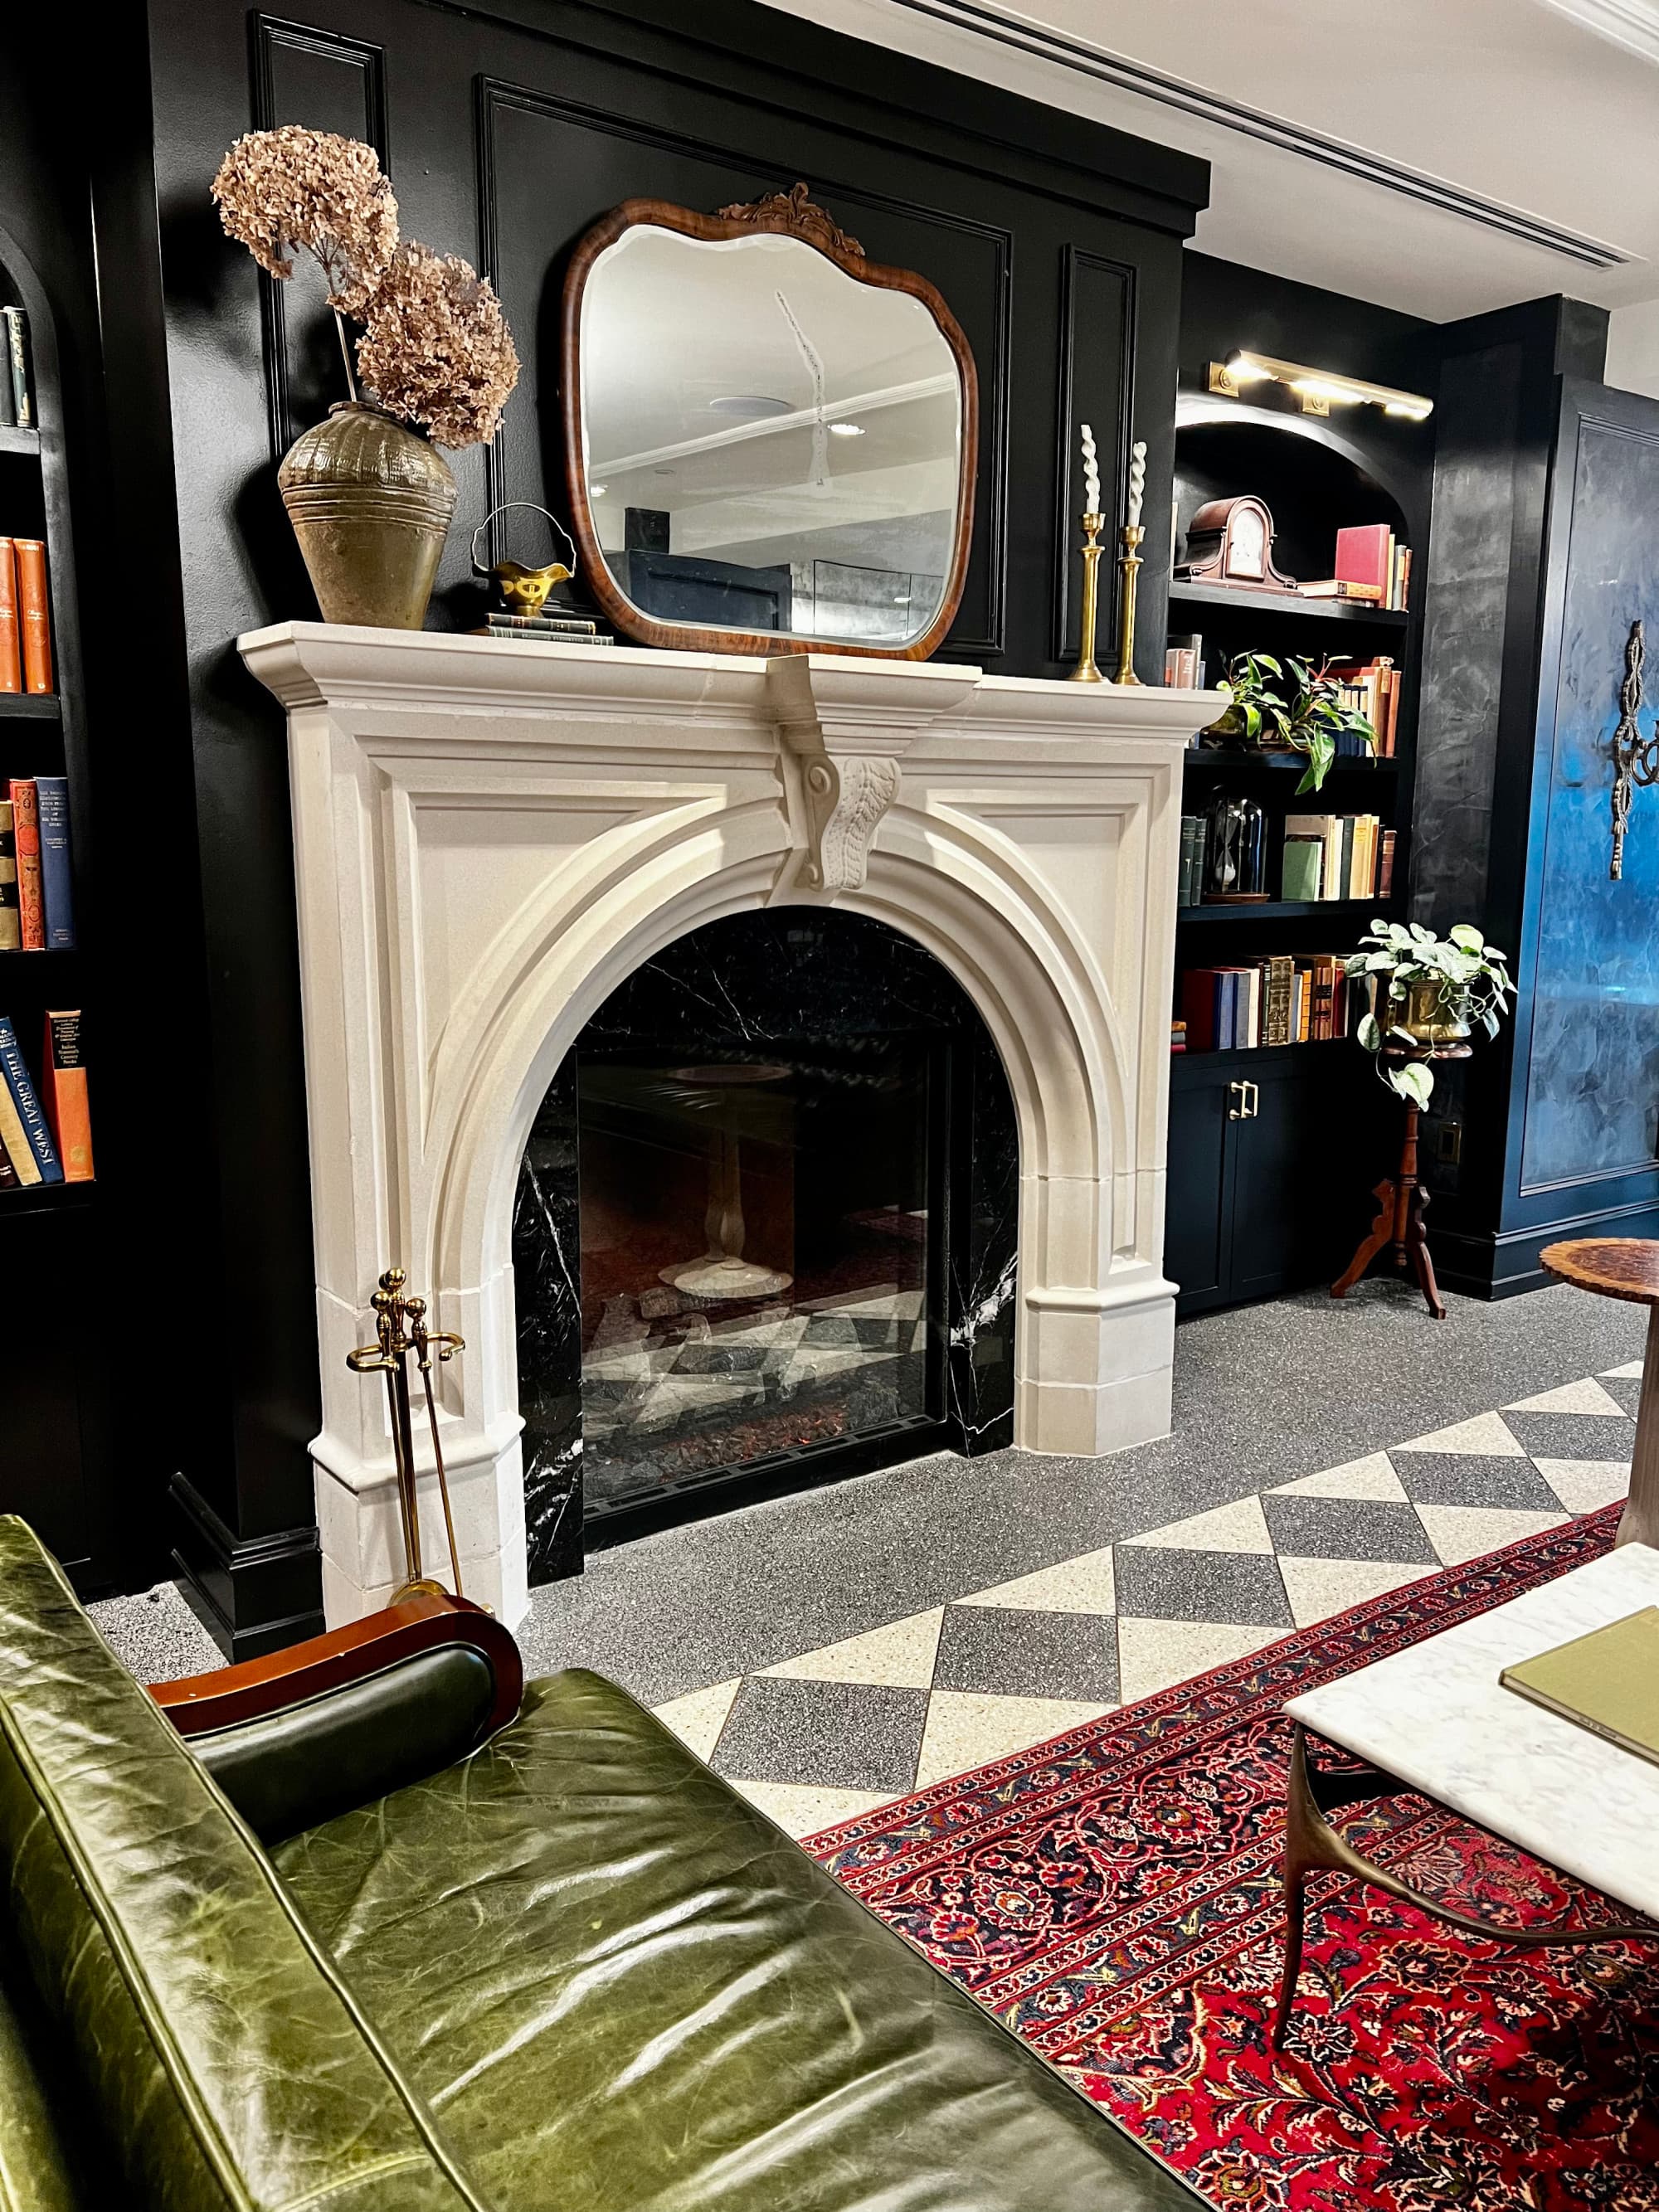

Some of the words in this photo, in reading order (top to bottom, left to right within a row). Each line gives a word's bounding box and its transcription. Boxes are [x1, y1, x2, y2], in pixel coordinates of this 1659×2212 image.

[7, 1052, 26, 1081] THE
[17, 1081, 42, 1125] GREAT
[33, 1128, 56, 1165] WEST
